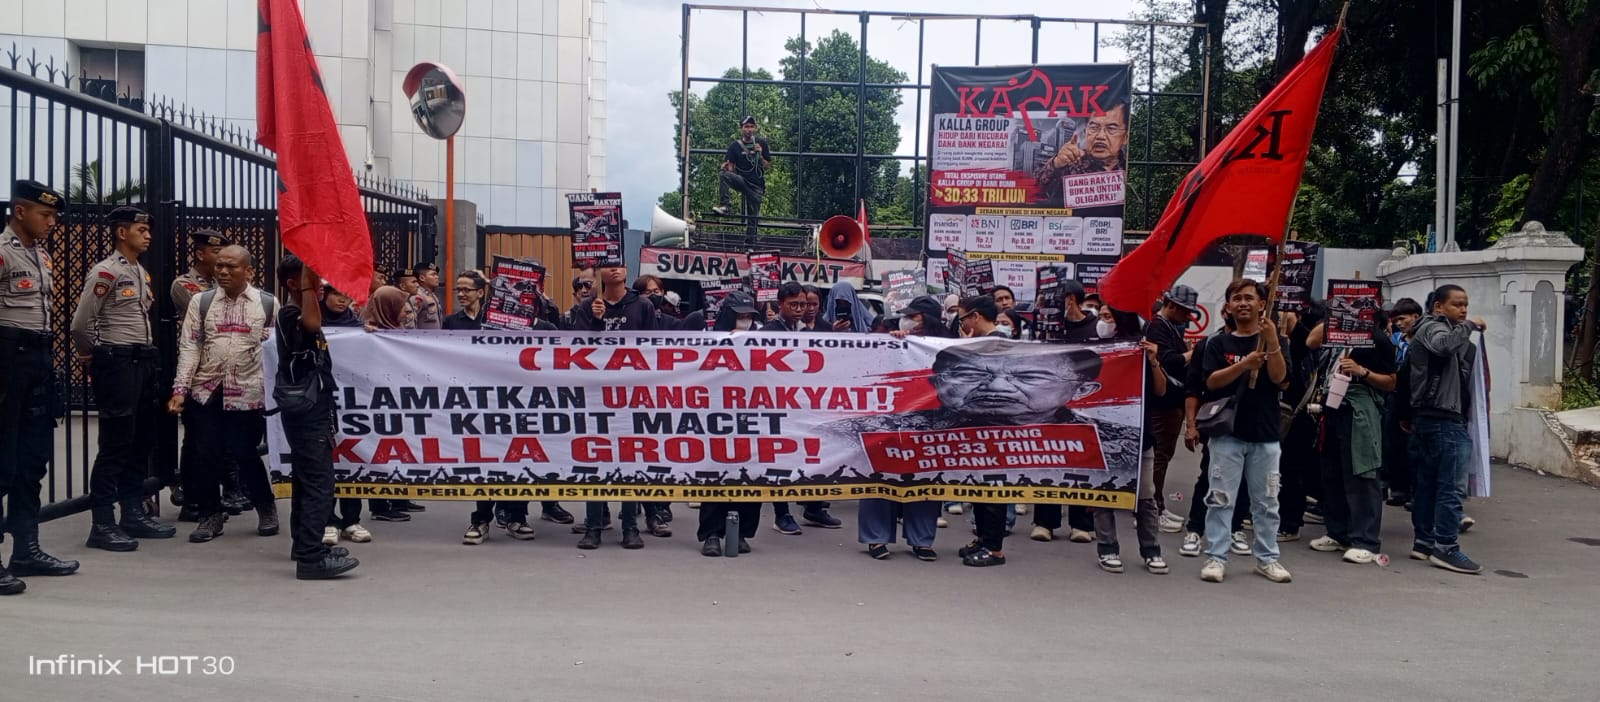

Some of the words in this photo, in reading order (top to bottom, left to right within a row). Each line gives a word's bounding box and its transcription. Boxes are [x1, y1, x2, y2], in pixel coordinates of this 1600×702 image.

[940, 118, 972, 131] KALLA
[975, 118, 1010, 131] GROUP
[938, 132, 958, 140] HIDUP
[960, 132, 975, 140] DARI
[977, 132, 1009, 140] KUCURAN
[938, 140, 956, 148] DANA
[958, 140, 976, 148] BANK
[978, 141, 1008, 149] NEGARA!
[938, 179, 955, 187] KALLA
[1068, 178, 1089, 188] UANG
[1069, 186, 1095, 196] BUKAN
[1096, 183, 1122, 193] UNTUK
[568, 194, 595, 202] UANG
[944, 187, 978, 204] 30,33
[981, 188, 1026, 203] TRILIUN
[1075, 193, 1116, 204] OLIGARKI!
[981, 219, 1000, 229] BNI
[1021, 220, 1038, 230] BRI
[657, 253, 740, 277] SUARA
[782, 261, 844, 284] KYAT
[471, 335, 561, 345] KOMITE
[571, 336, 626, 346] AKSI
[635, 336, 735, 347] PEMUDA
[744, 337, 799, 347] ANTI
[808, 338, 910, 350] KORUPSI
[518, 347, 825, 374] (KAPAK)
[330, 386, 586, 410] ELAMATKAN
[602, 385, 710, 409] UANG
[722, 385, 888, 410] RAKYAT!
[336, 413, 433, 436] SUT
[450, 412, 616, 435] KREDIT
[632, 412, 787, 435] MACET
[909, 432, 971, 445] TOTAL
[976, 428, 1043, 441] UTANG
[331, 437, 550, 464] KALLA
[571, 436, 821, 465] GROUP!
[885, 447, 916, 461] Rp
[923, 442, 987, 457] 30,33
[994, 439, 1085, 453] TRILIUN
[918, 457, 938, 469] DI
[944, 455, 998, 467] BANK
[1005, 454, 1067, 466] BUMN
[335, 486, 409, 495] TIKAN
[416, 487, 550, 497] PERLAKUAN
[558, 488, 674, 497] ISTIMEWA!
[682, 488, 762, 497] HUKUM
[769, 487, 843, 497] HARUS
[851, 485, 946, 498] BERLAKU
[953, 488, 1025, 498] UNTUK
[1033, 490, 1118, 503] SEMUA!
